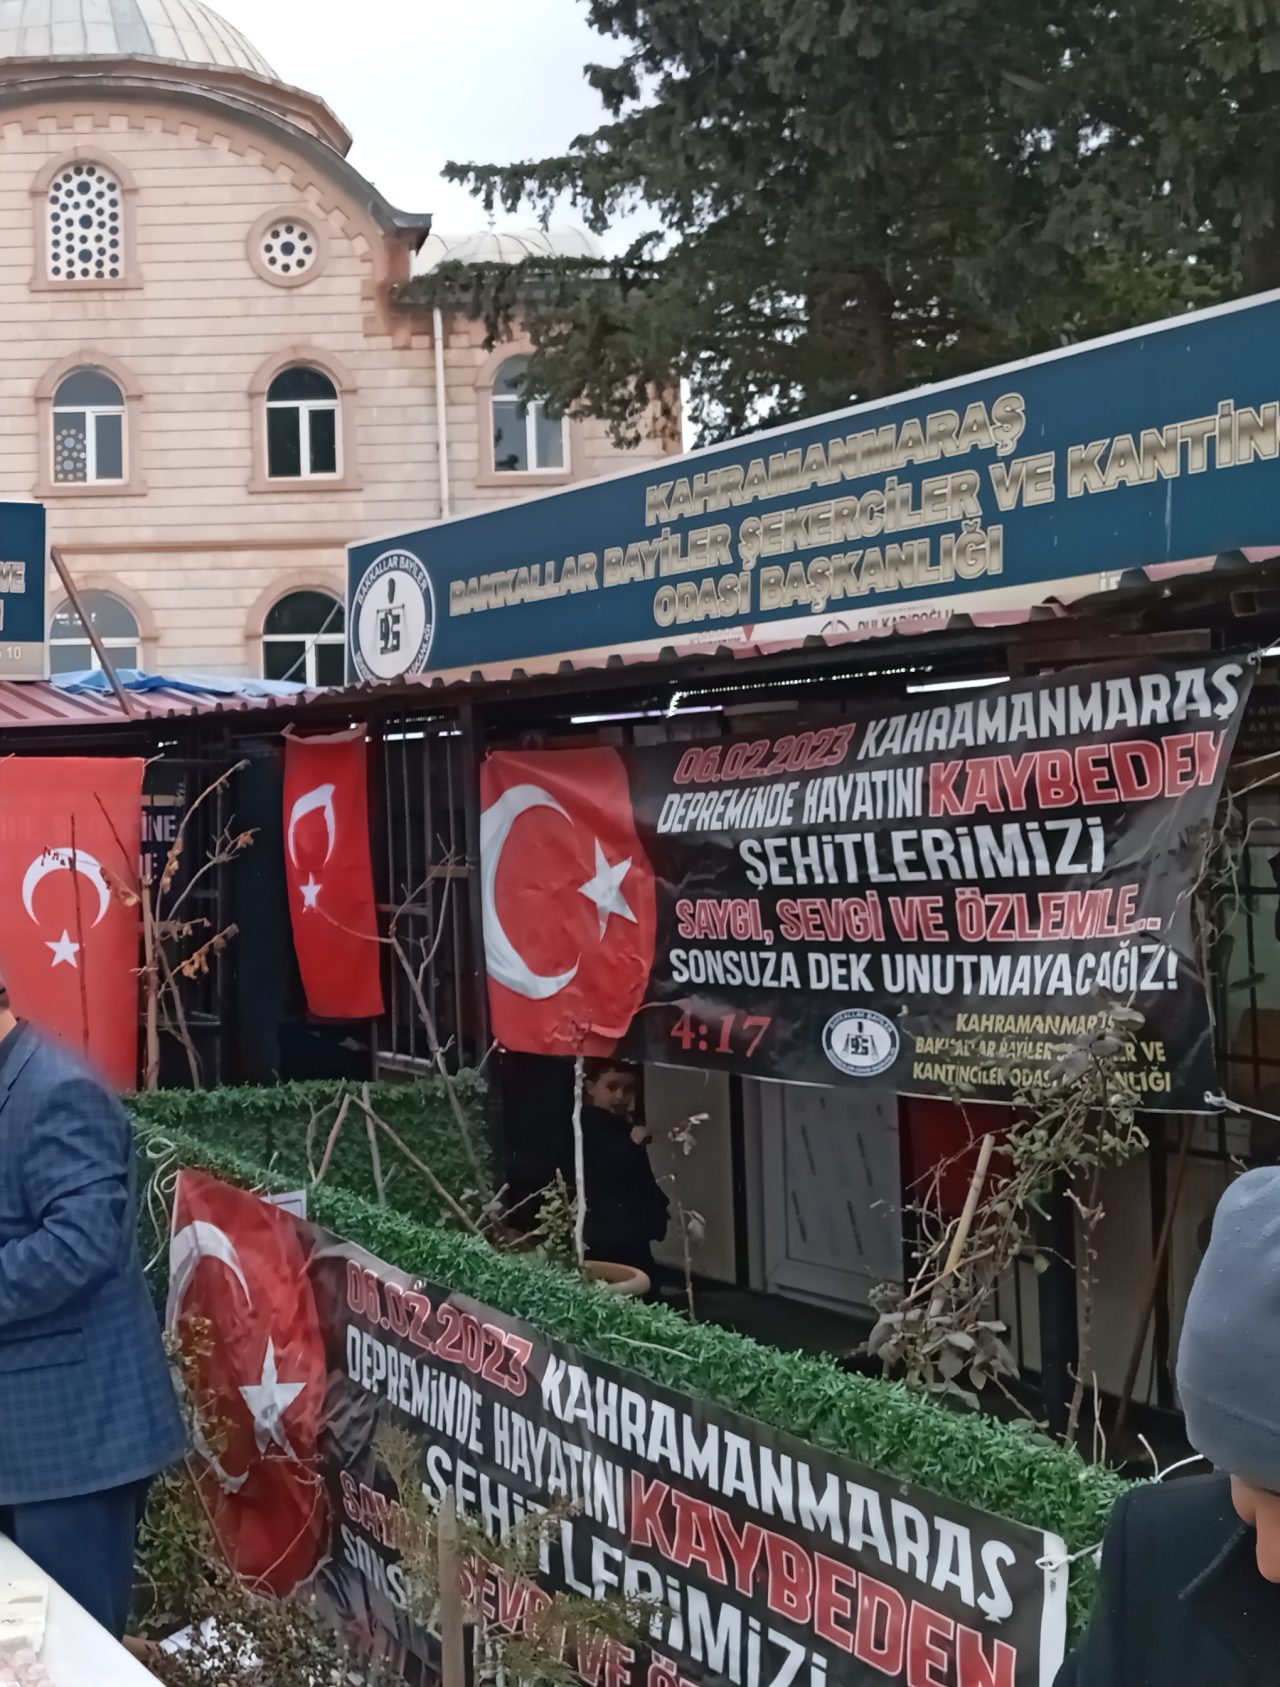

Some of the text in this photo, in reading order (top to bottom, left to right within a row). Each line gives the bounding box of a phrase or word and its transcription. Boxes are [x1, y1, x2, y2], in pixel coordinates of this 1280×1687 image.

[449, 398, 1280, 617] BAKKALLAR BAYİLER ŞEKERCİLER VE KANTİN
[645, 391, 1026, 527] KAHRAMANMARAŞ
[653, 518, 1004, 628] ODASI BAŞKANLIĞI
[7, 645, 21, 659] 10
[673, 662, 1243, 785] 06.02.2023 KAHRAMANMARAŞ
[656, 729, 1228, 834] DEPREMİNDE HAYATINI KAYBEDEN
[739, 816, 1106, 891] ŞEHİTLERİMİZİ
[669, 939, 1179, 997] SONSUZA DEK UNUTMAYACAĞIZ!
[676, 898, 774, 946] SAYGI,
[776, 890, 886, 942] SEVGİ
[888, 895, 950, 942] VE
[670, 1009, 772, 1058] 4:17
[1140, 1041, 1166, 1062] VE
[345, 1259, 1017, 1625] 06.02.2023 KAHRAMANMARAŞ
[346, 1324, 484, 1455] DEPREMİNDE
[493, 1402, 626, 1535] HAYATINI
[630, 1469, 1017, 1687] KAYBEDEN
